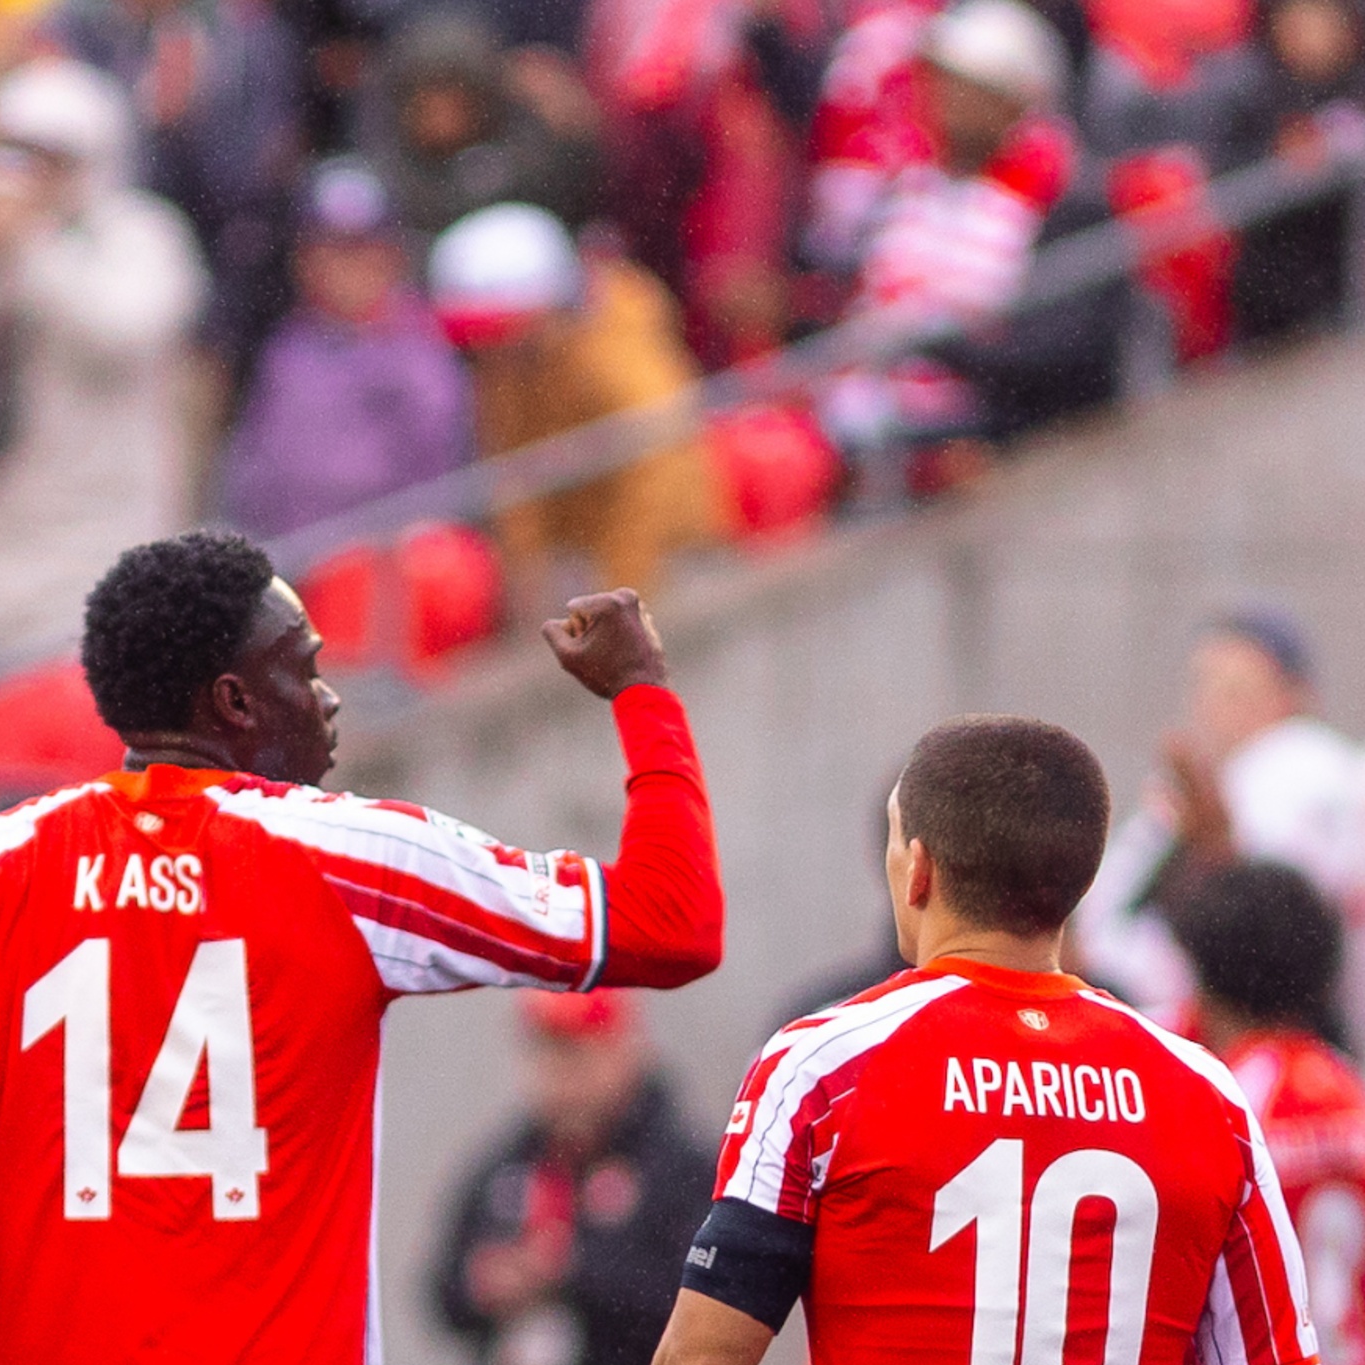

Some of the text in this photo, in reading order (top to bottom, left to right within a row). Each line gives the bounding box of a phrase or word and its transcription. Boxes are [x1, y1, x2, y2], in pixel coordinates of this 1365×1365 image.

[115, 853, 207, 914] ASS
[21, 937, 269, 1220] 14
[943, 1056, 1147, 1123] APARICIO
